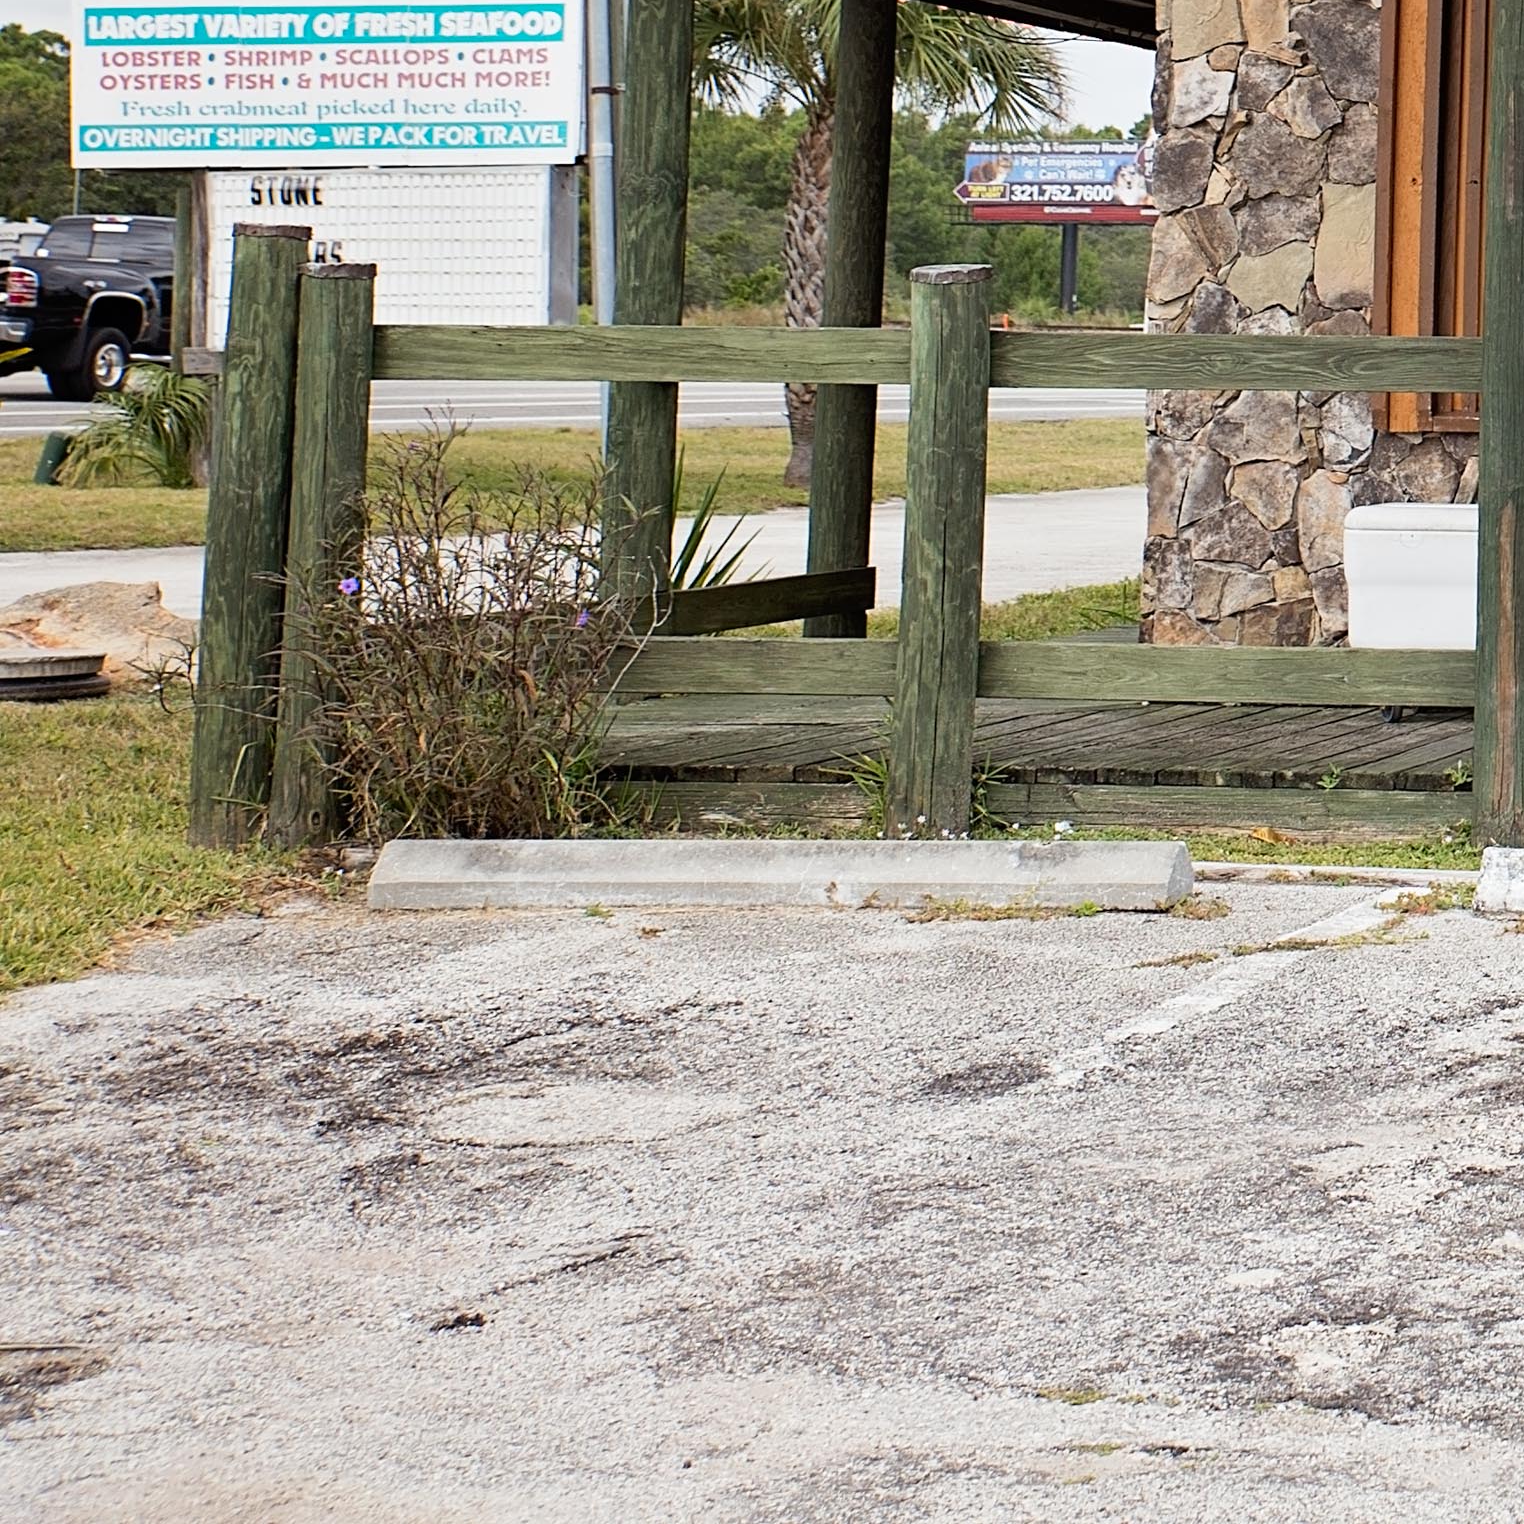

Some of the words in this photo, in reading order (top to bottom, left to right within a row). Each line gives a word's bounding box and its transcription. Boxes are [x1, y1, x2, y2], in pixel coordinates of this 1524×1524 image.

[87, 15, 200, 40] LARGEST
[202, 13, 309, 39] VARIETY
[312, 12, 351, 38] OF
[354, 12, 436, 38] FRESH
[439, 10, 562, 37] SEAFOOD
[101, 51, 201, 67] LOBSTER
[224, 50, 313, 67] SHRIMP
[335, 49, 450, 65] SCALLOPS
[472, 47, 548, 64] CLAMS
[100, 73, 202, 91] OYSTERS
[224, 74, 275, 90] FISH
[297, 73, 311, 89] &
[320, 72, 388, 89] MUCH
[397, 72, 466, 89] MUCH
[475, 70, 551, 87] MORE!
[121, 100, 190, 117] Fresh
[199, 100, 307, 117] crabmeat
[316, 99, 395, 120] picked
[403, 98, 456, 115] here
[464, 98, 527, 118] daily.
[82, 128, 215, 148] OVERNIGHT
[216, 127, 317, 148] SHIPPING
[331, 127, 365, 146] WE
[368, 126, 428, 146] PACK
[432, 126, 479, 146] FOR
[480, 125, 565, 145] TRAVEL
[1010, 183, 1114, 202] 321.752.7600
